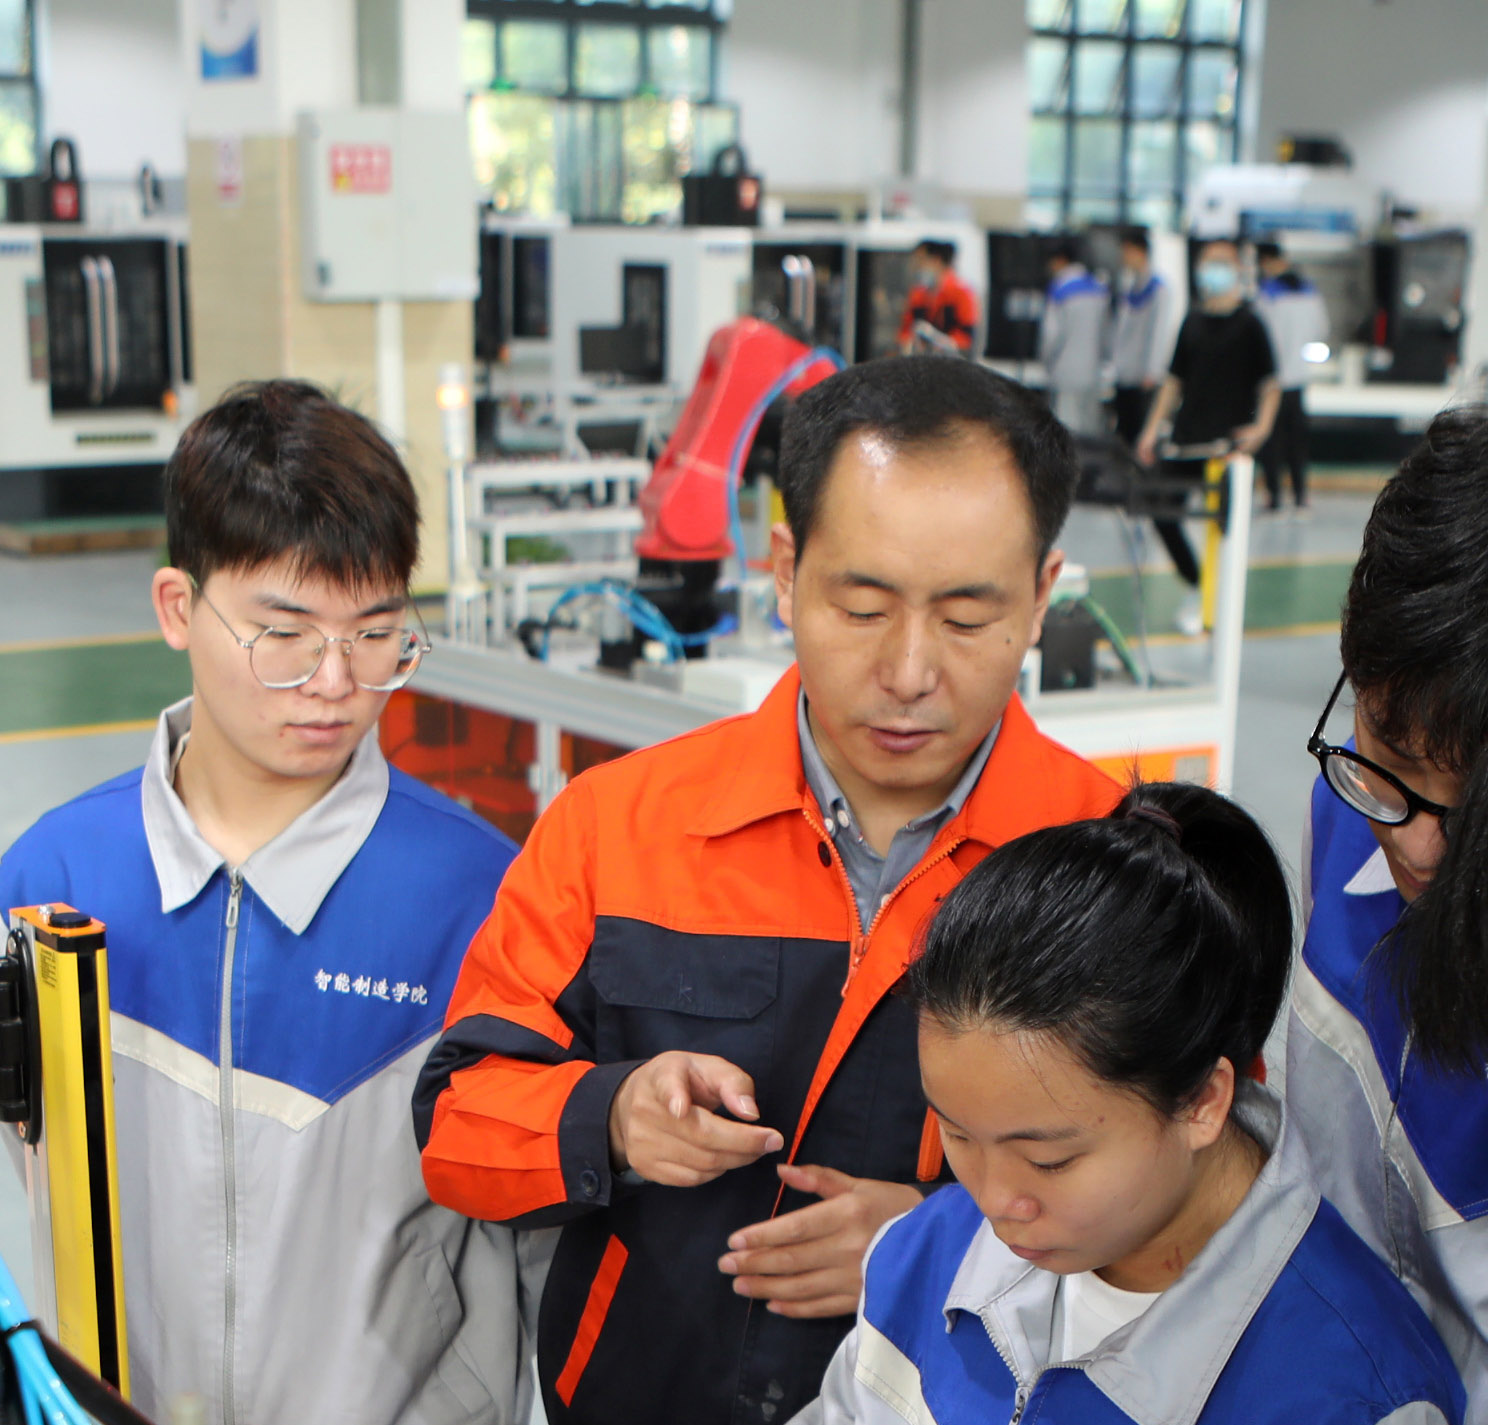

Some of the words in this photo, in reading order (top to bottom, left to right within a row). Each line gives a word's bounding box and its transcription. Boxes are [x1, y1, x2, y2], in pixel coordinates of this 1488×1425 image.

[314, 968, 428, 1005] 智能制造学院
